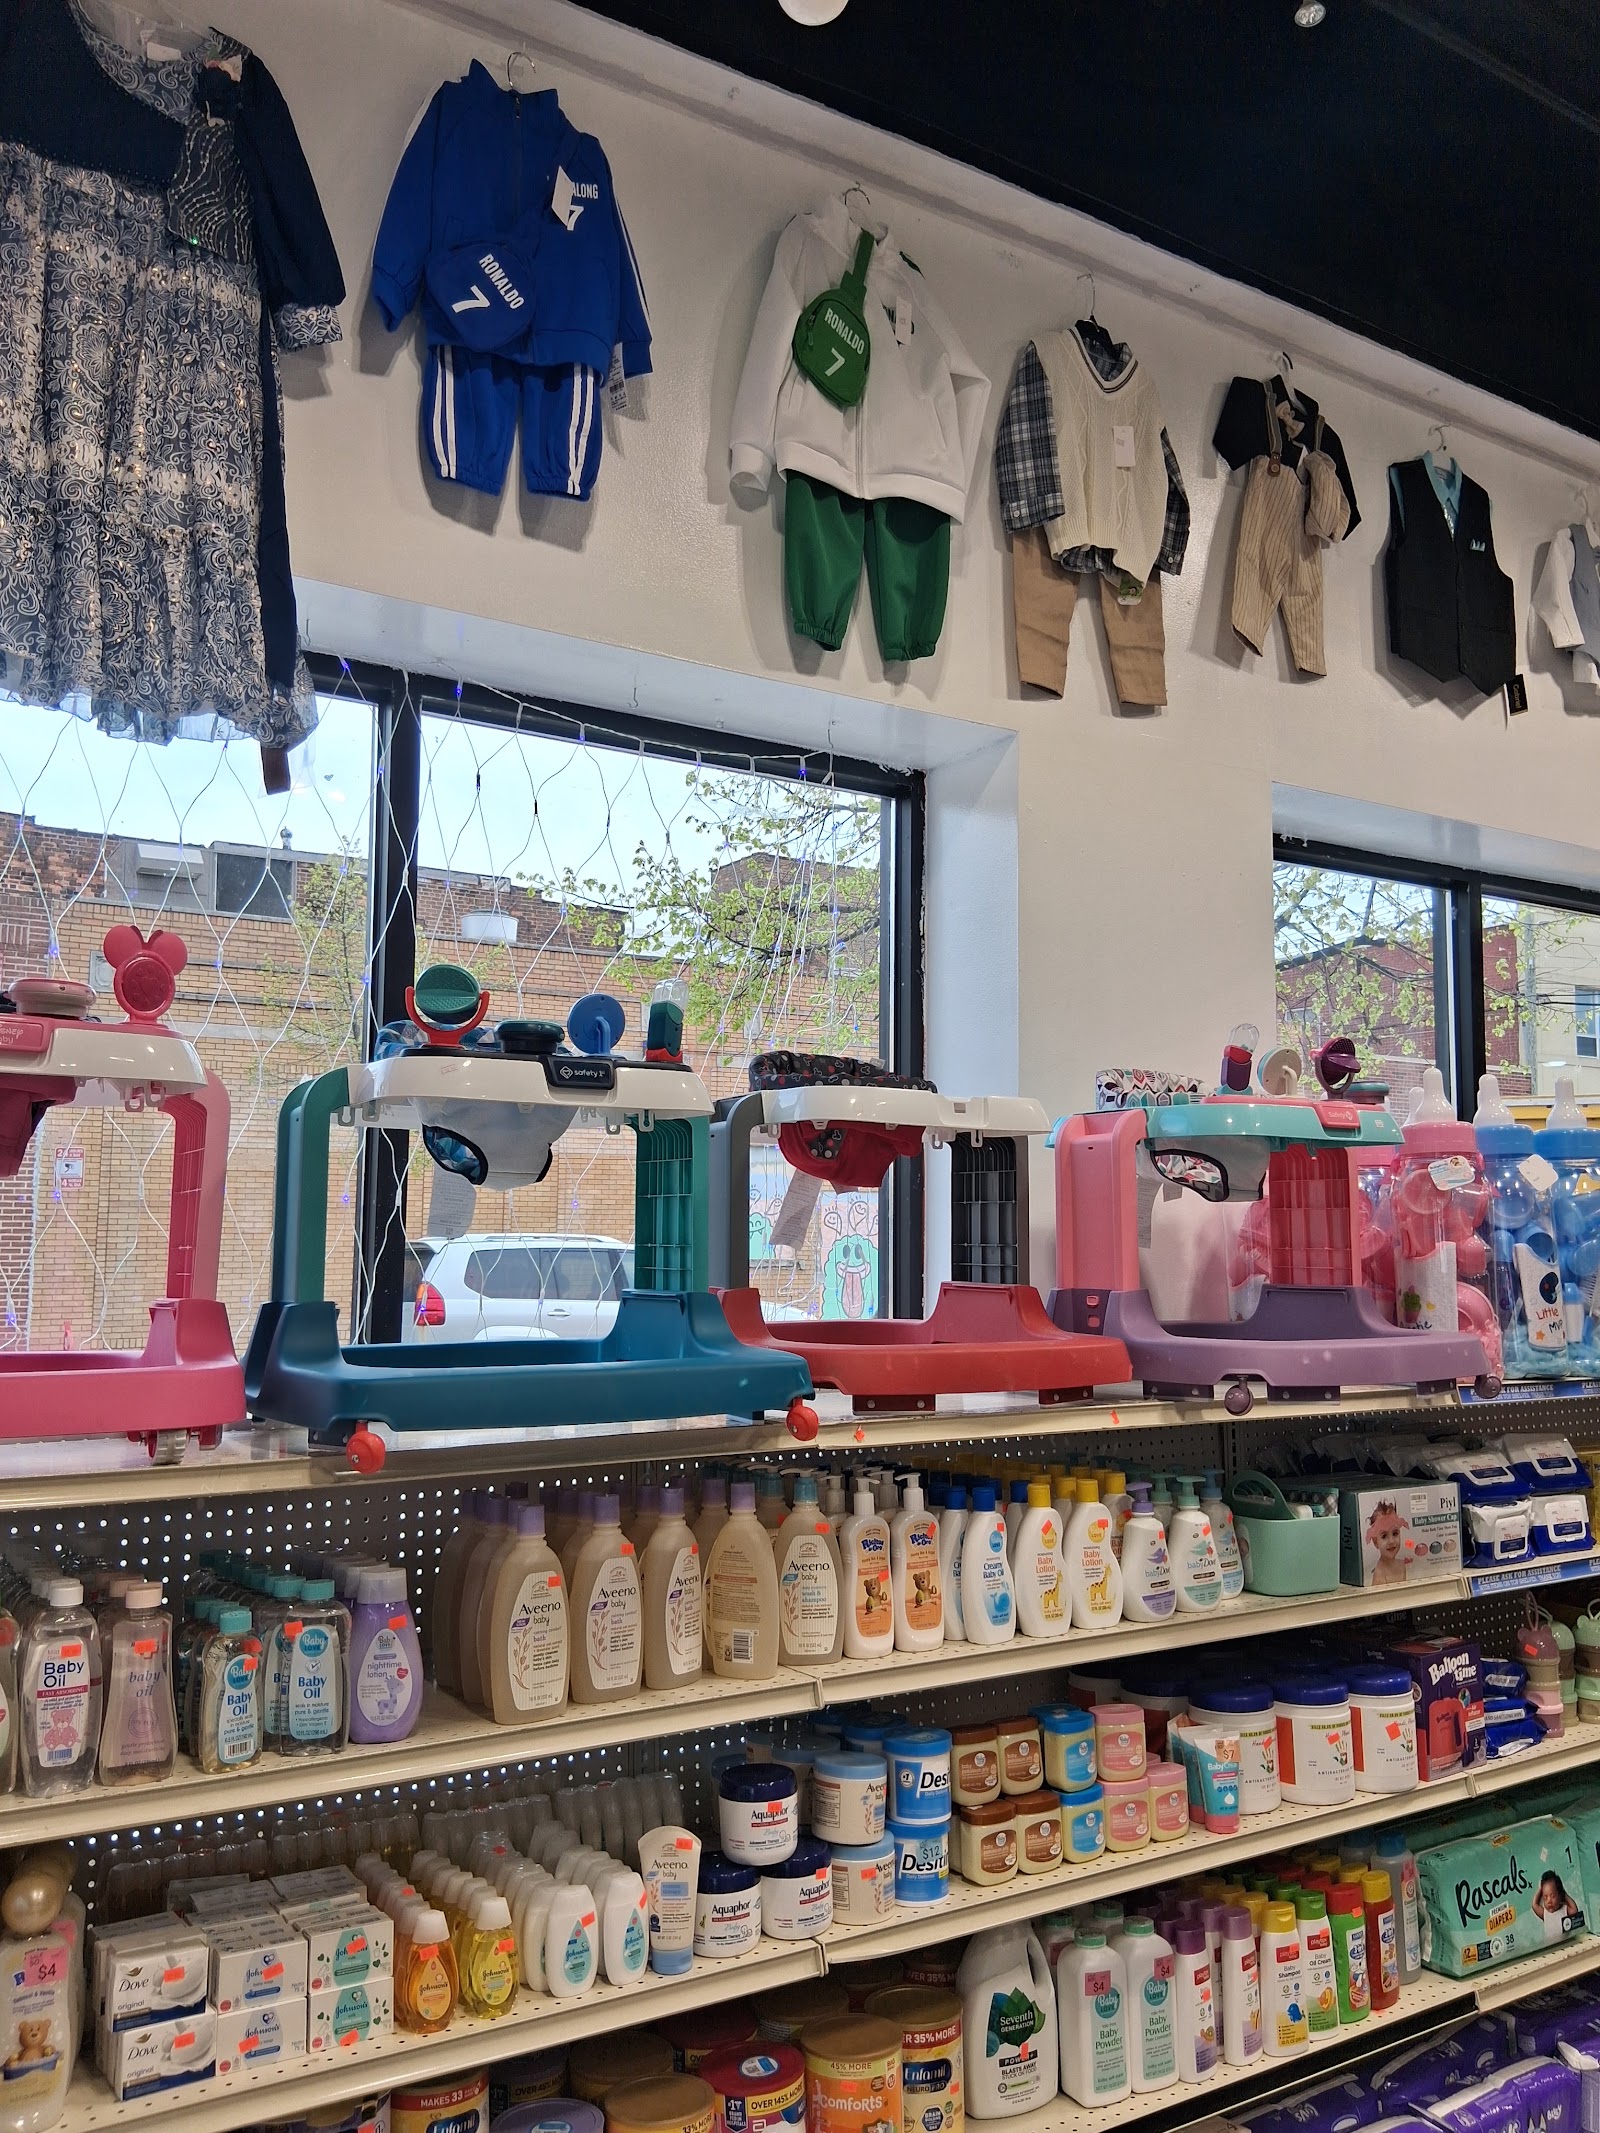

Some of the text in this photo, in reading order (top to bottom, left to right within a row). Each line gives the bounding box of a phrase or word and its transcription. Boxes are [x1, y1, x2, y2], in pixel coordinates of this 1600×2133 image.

[567, 205, 584, 231] 7
[479, 253, 524, 309] RONALDO
[452, 285, 490, 313] 7
[824, 307, 865, 354] RONALDO
[824, 347, 845, 377] 7
[574, 1070, 598, 1078] safety
[1536, 1307, 1560, 1320] Little
[1507, 1386, 1519, 1394] FOR
[1520, 1384, 1554, 1392] ASSISTANCE
[1440, 1496, 1456, 1510] Piyl
[1414, 1513, 1457, 1525] Baby Shower Cap
[1037, 1557, 1053, 1565] Baby
[1083, 1550, 1100, 1559] Baby
[788, 1560, 830, 1572] Aveeno
[984, 1561, 1003, 1570] Creamy
[1082, 1557, 1103, 1567] Lotion
[983, 1570, 996, 1579] Baby
[1036, 1565, 1056, 1573] Lotion
[1478, 1565, 1561, 1585] PLEASE ASK FOR ASSISTANCE
[674, 1573, 700, 1587] Aveeno
[802, 1573, 818, 1583] baby
[598, 1586, 637, 1599] Aveeno
[684, 1587, 694, 1598] baby
[519, 1601, 561, 1616] Aveeno
[610, 1599, 626, 1609] baby
[533, 1615, 550, 1627] baby
[302, 1634, 325, 1648] Baby
[44, 1660, 85, 1676] Baby
[367, 1661, 402, 1671] nighttime
[1428, 1652, 1470, 1686] Balloon
[129, 1669, 161, 1683] baby
[1454, 1665, 1477, 1681] time
[43, 1675, 66, 1688] Oil
[298, 1675, 327, 1688] Baby
[136, 1685, 154, 1698] oil
[303, 1688, 320, 1699] Oil
[227, 1692, 252, 1706] Baby
[232, 1704, 248, 1716] Oil
[1222, 1749, 1235, 1759] $7
[920, 1767, 949, 1789] Desi
[866, 1783, 886, 1793] Aveen
[922, 1846, 940, 1860] $12
[1564, 1845, 1572, 1864] 1
[651, 1860, 688, 1869] Aveeno
[875, 1860, 894, 1872] Aveen
[663, 1870, 677, 1880] baby
[799, 1880, 830, 1899] Aquaphor
[1455, 1855, 1529, 1928] Rascals
[712, 1901, 750, 1918] Aquaphor
[1491, 1904, 1508, 1915] PREMIUM
[1489, 1910, 1513, 1931] DIAPERS
[1505, 1934, 1515, 1945] 38
[1464, 1948, 1472, 1959] 12
[1309, 1957, 1332, 1967] Oil Cream
[38, 1963, 57, 1981] $4
[482, 1967, 510, 1981] Johnson's
[1160, 1965, 1170, 1977] $4
[1278, 1970, 1301, 1978] Shampoo
[118, 1978, 149, 1992] Dove
[419, 1982, 448, 1996] Johnson's
[1093, 1981, 1105, 1993] $4
[1146, 1980, 1167, 1994] Baby
[117, 2000, 145, 2010] original
[1097, 1993, 1119, 2007] Baby
[335, 2001, 368, 2019] Johnson's
[1000, 2009, 1033, 2026] Seventh
[1149, 2015, 1168, 2027] Baby
[245, 2023, 280, 2038] Johnson's
[1001, 2020, 1034, 2033] GENERATION
[1145, 2023, 1171, 2037] Powder
[914, 2025, 956, 2044] 35% MORE
[1099, 2028, 1119, 2040] Baby
[1095, 2036, 1122, 2050] Powder
[127, 2045, 158, 2061] Dove
[127, 2066, 154, 2078] original
[830, 2062, 872, 2070] 45% MORE
[904, 2064, 946, 2081] Enfamil
[1001, 2061, 1037, 2076] BLASTS AWAY
[1001, 2072, 1018, 2080] STUCK
[1025, 2067, 1037, 2075] FOOD
[906, 2082, 945, 2093] NEURO PRO
[420, 2090, 463, 2107] MAKES 33
[751, 2081, 803, 2109] OVER 145% MORE
[925, 2110, 941, 2118] BRAIN
[682, 2112, 712, 2133] 33% MORE
